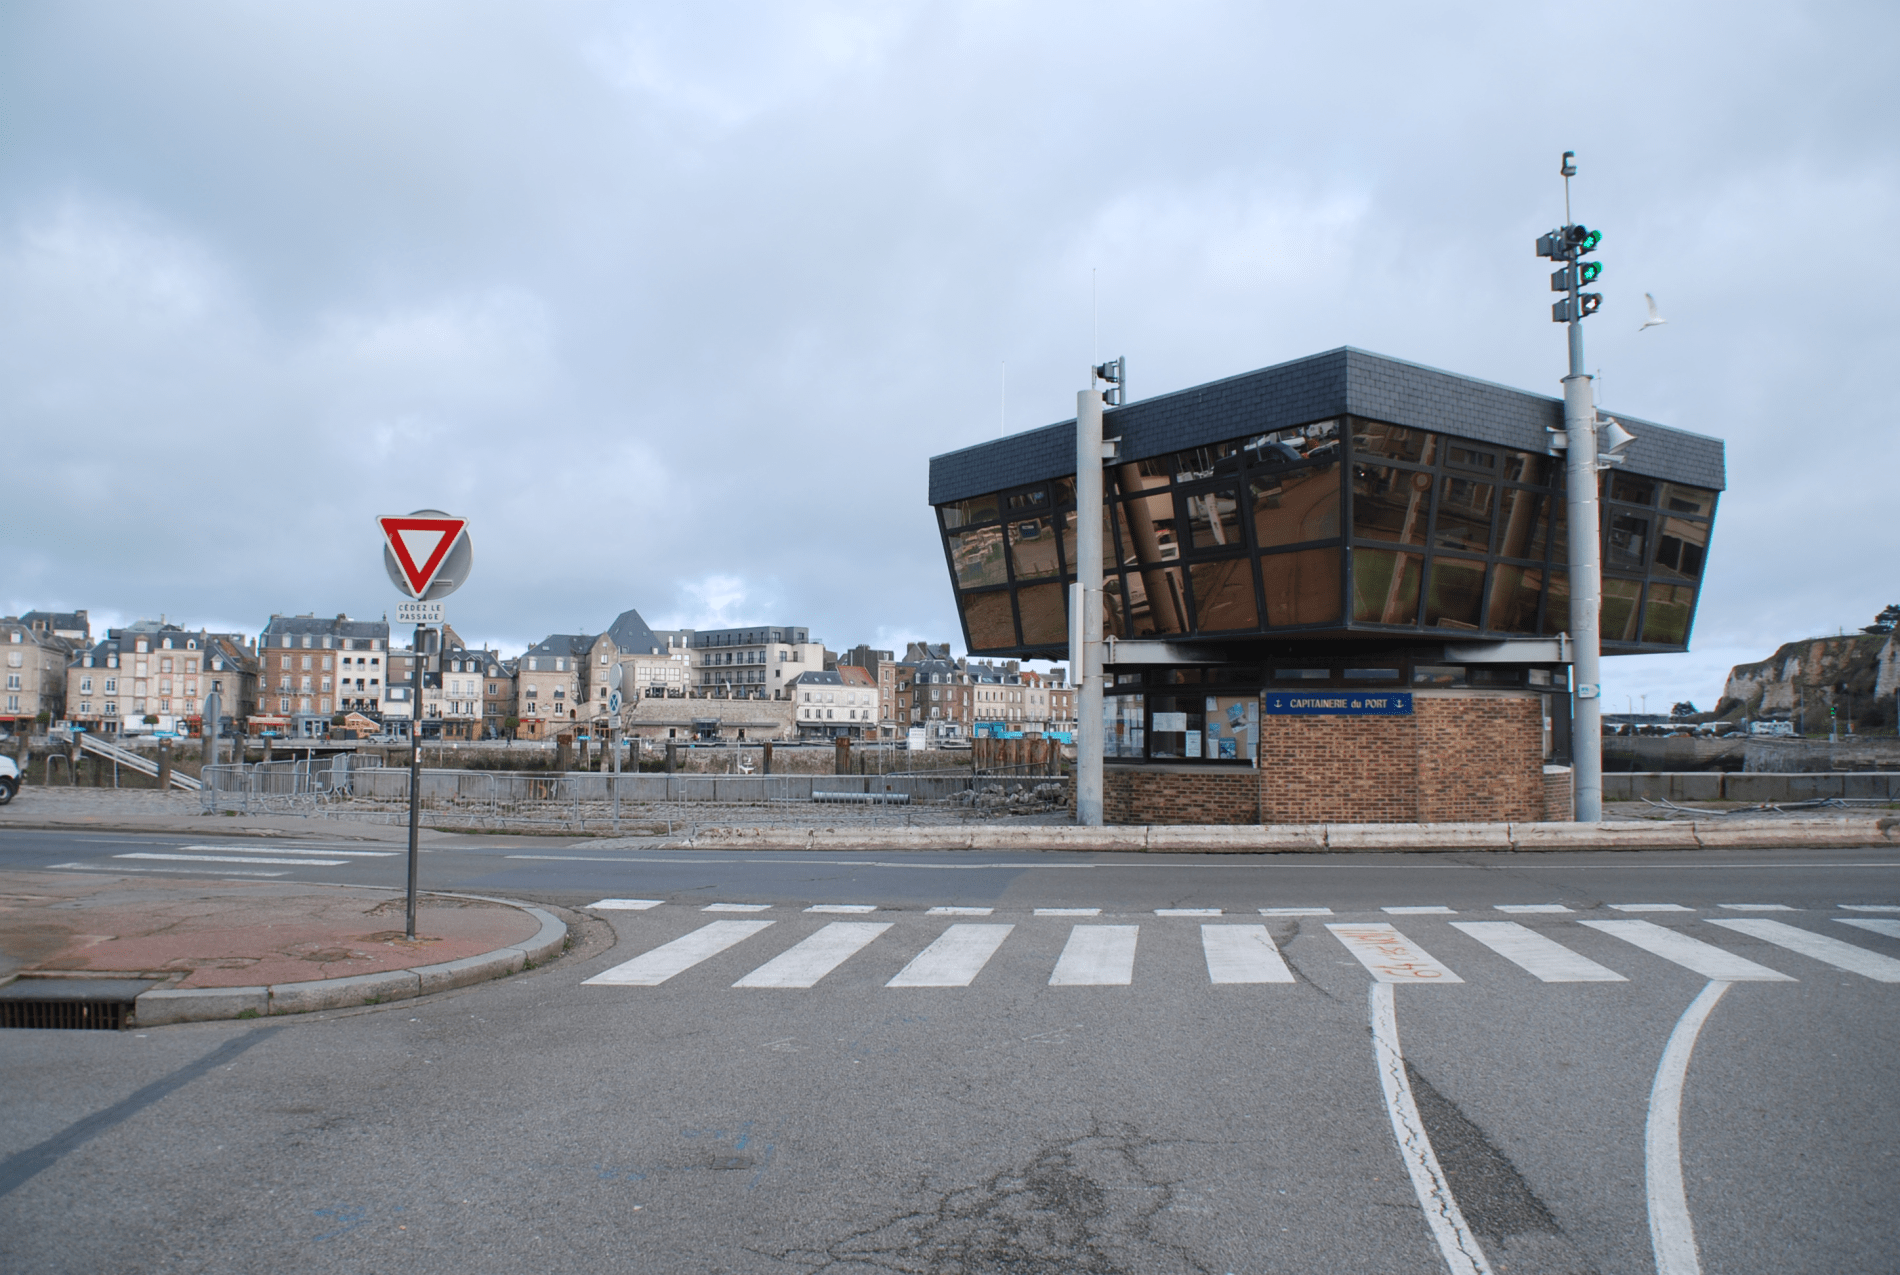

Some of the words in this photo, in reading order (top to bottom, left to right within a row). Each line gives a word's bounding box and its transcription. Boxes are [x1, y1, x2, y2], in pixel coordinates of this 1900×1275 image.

[1290, 699, 1348, 708] CAPITAINERIE
[1351, 699, 1362, 708] du
[1365, 699, 1388, 708] PORT
